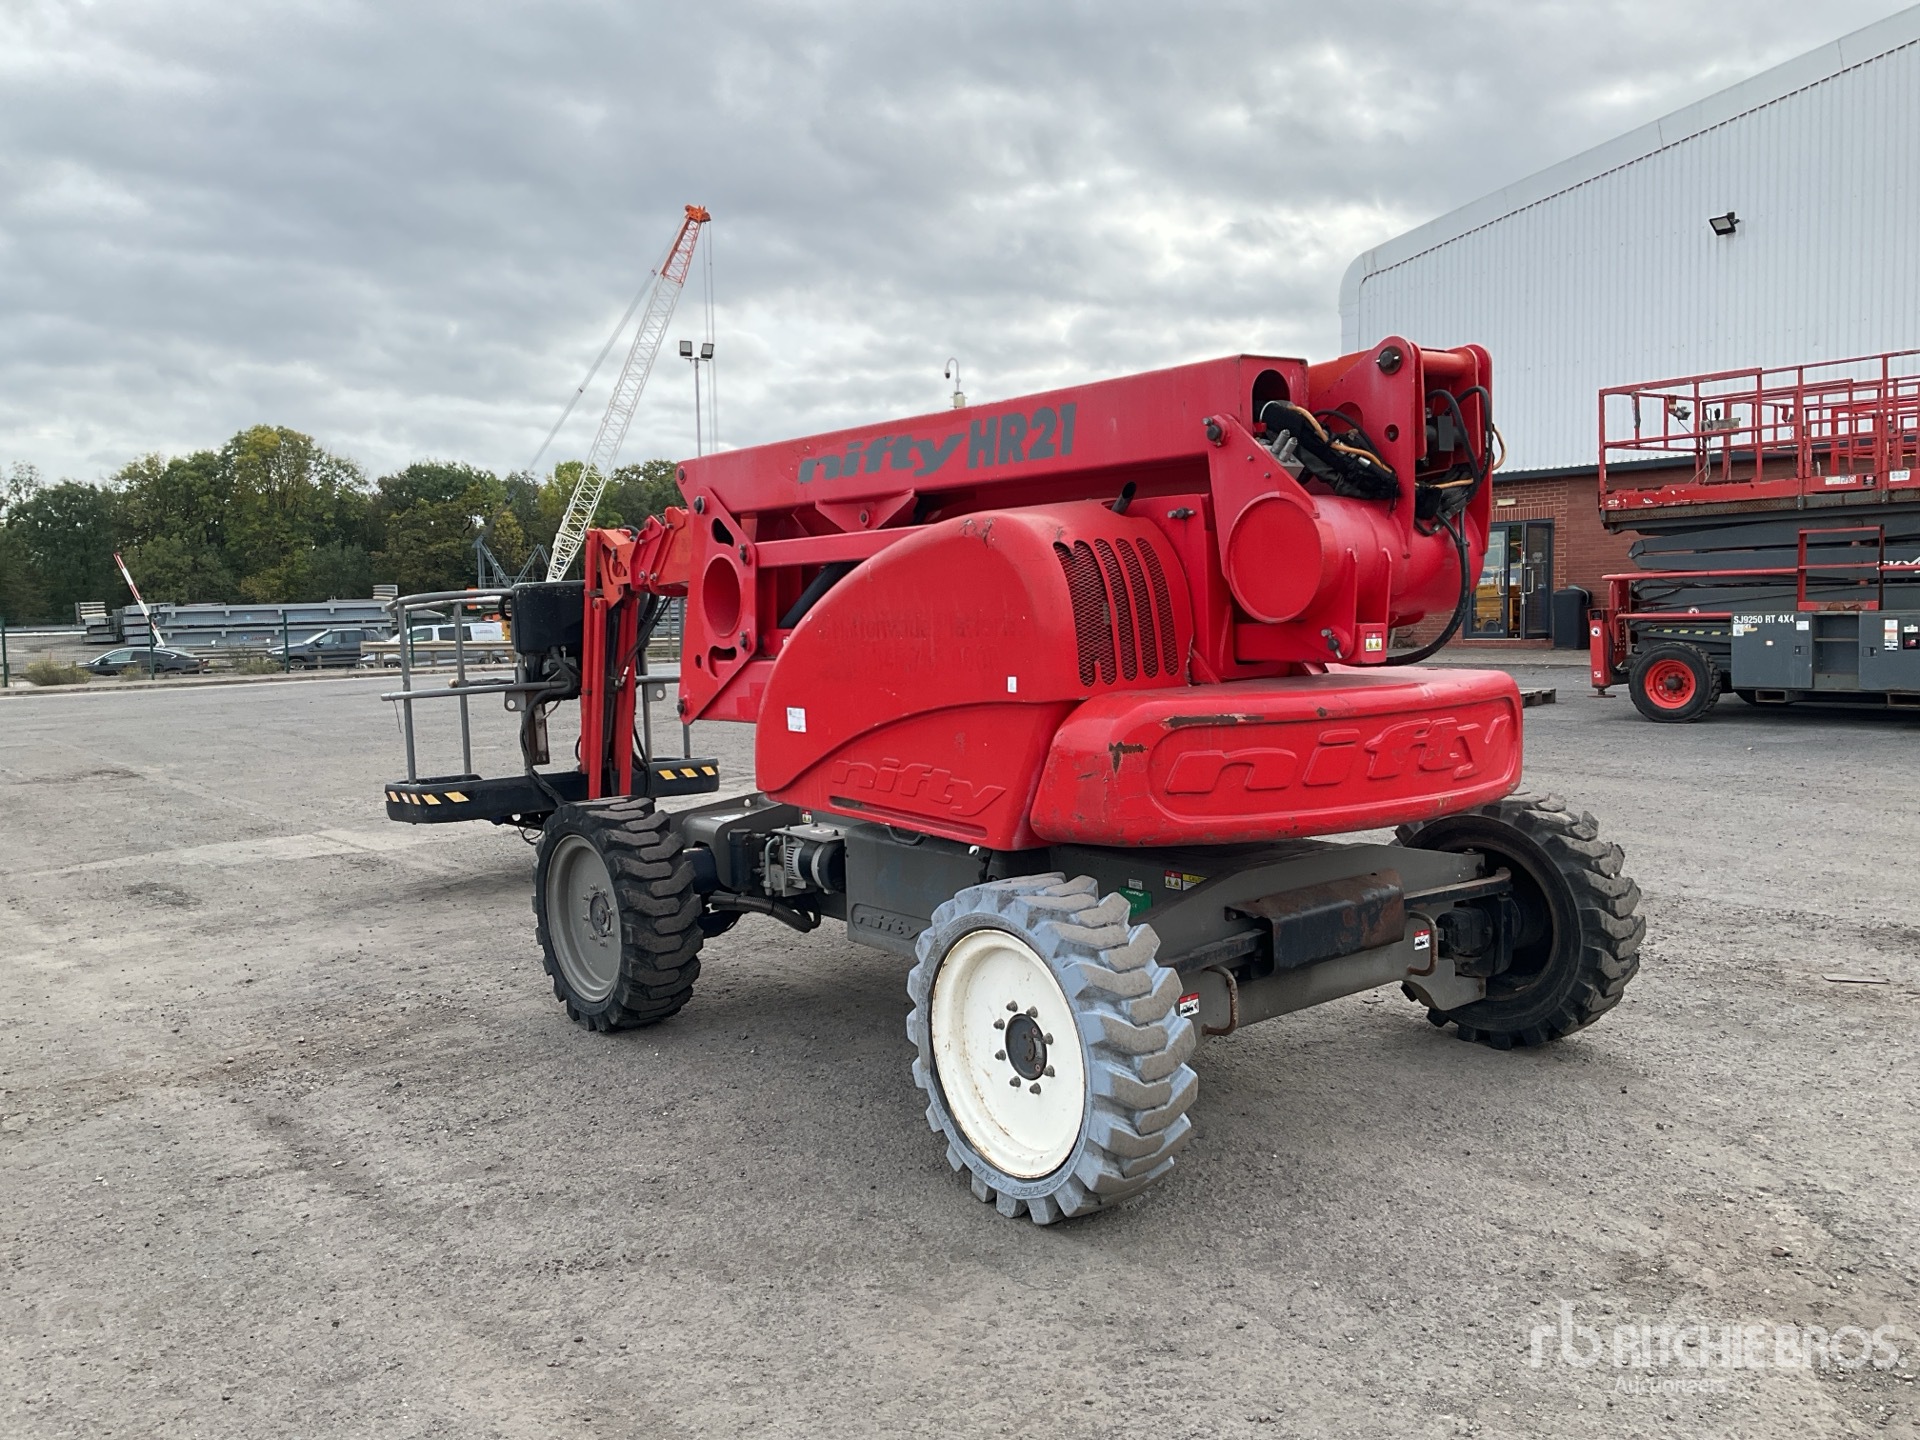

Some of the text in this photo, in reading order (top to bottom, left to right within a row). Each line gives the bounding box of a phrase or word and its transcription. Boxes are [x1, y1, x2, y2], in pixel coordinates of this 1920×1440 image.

[797, 402, 1078, 484] nifty HR21
[1733, 614, 1795, 624] SJ9250 RT 4X4
[1164, 715, 1510, 794] nifty
[831, 757, 1007, 818] nifty
[854, 912, 921, 941] nifty
